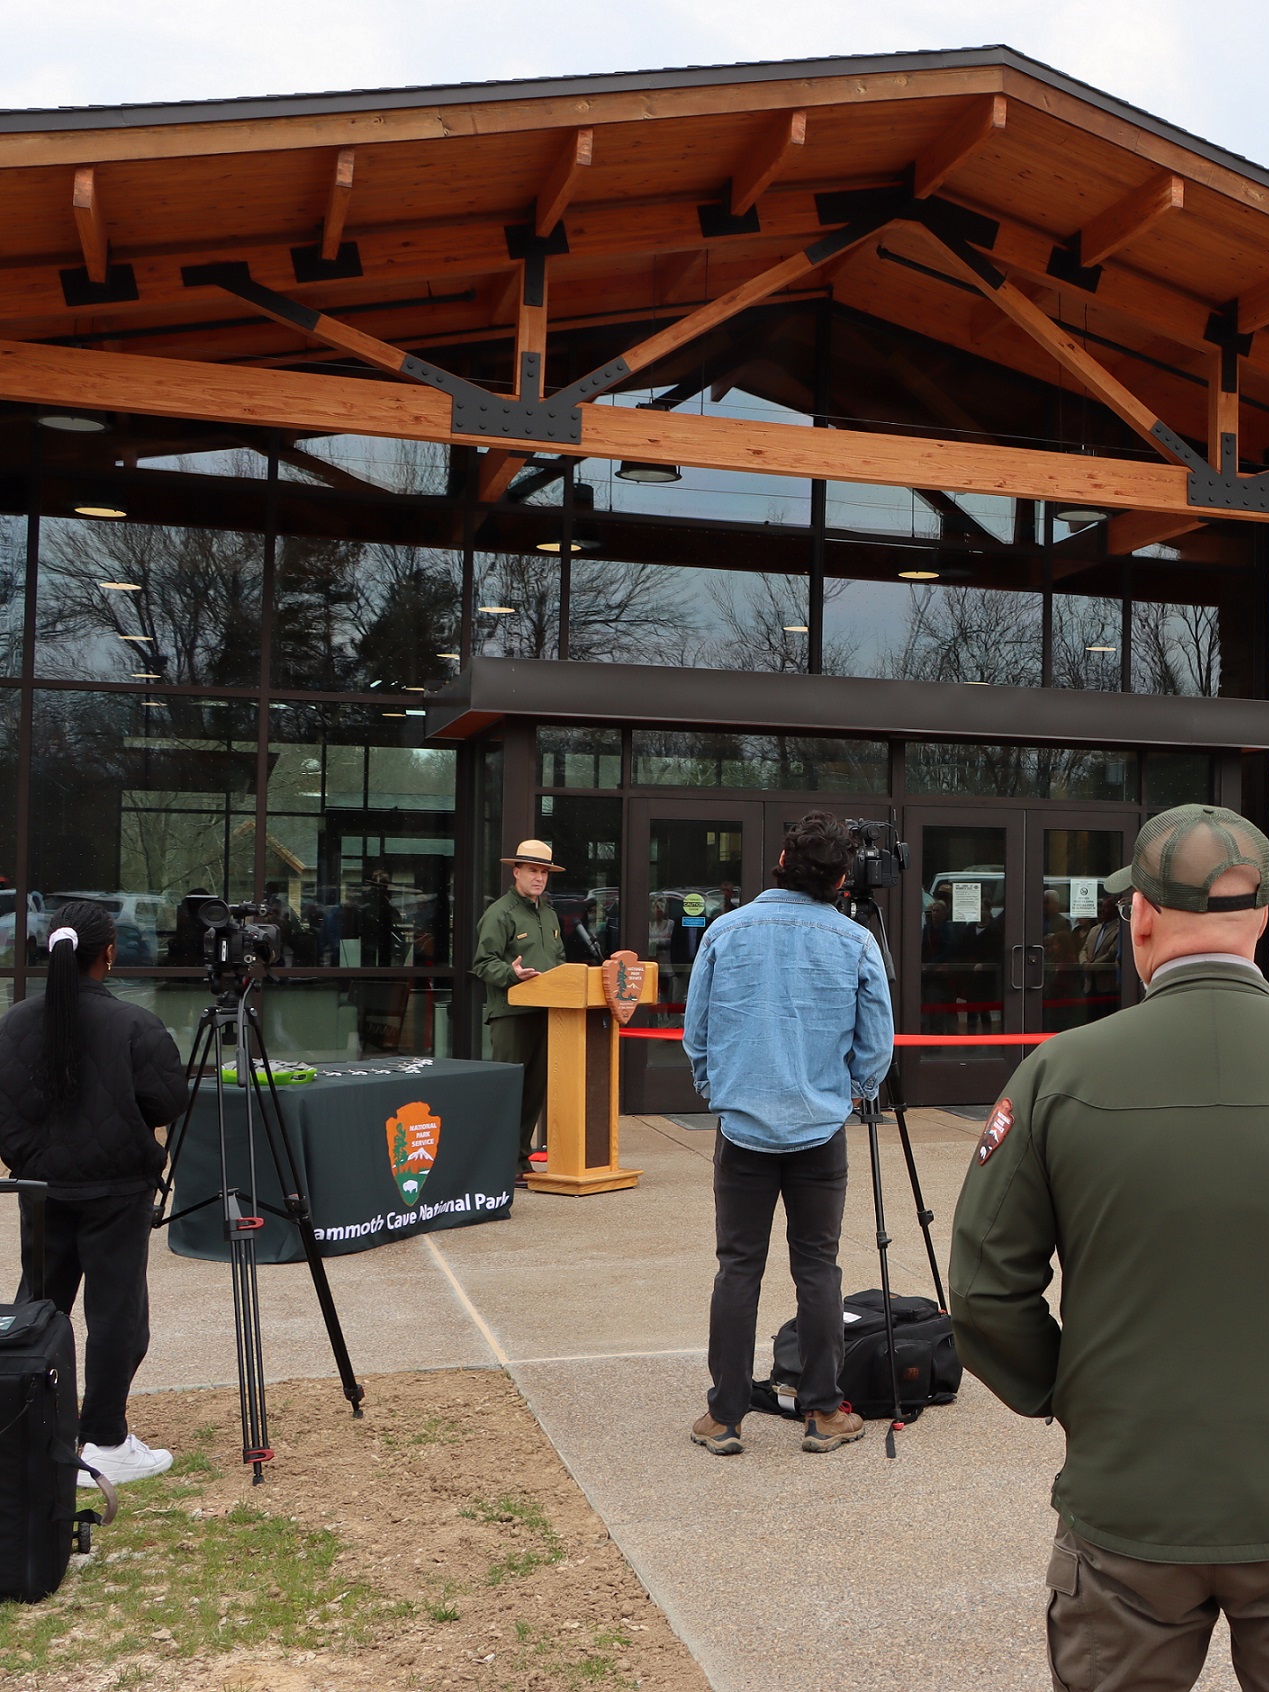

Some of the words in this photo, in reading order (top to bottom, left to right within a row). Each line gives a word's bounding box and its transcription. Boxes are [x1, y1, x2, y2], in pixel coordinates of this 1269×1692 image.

[409, 1122, 437, 1131] NATIONAL
[411, 1138, 434, 1147] SERVICE
[313, 1214, 385, 1241] ammoth
[386, 1211, 417, 1230] Cave
[418, 1193, 471, 1221] National
[475, 1190, 510, 1211] Park
